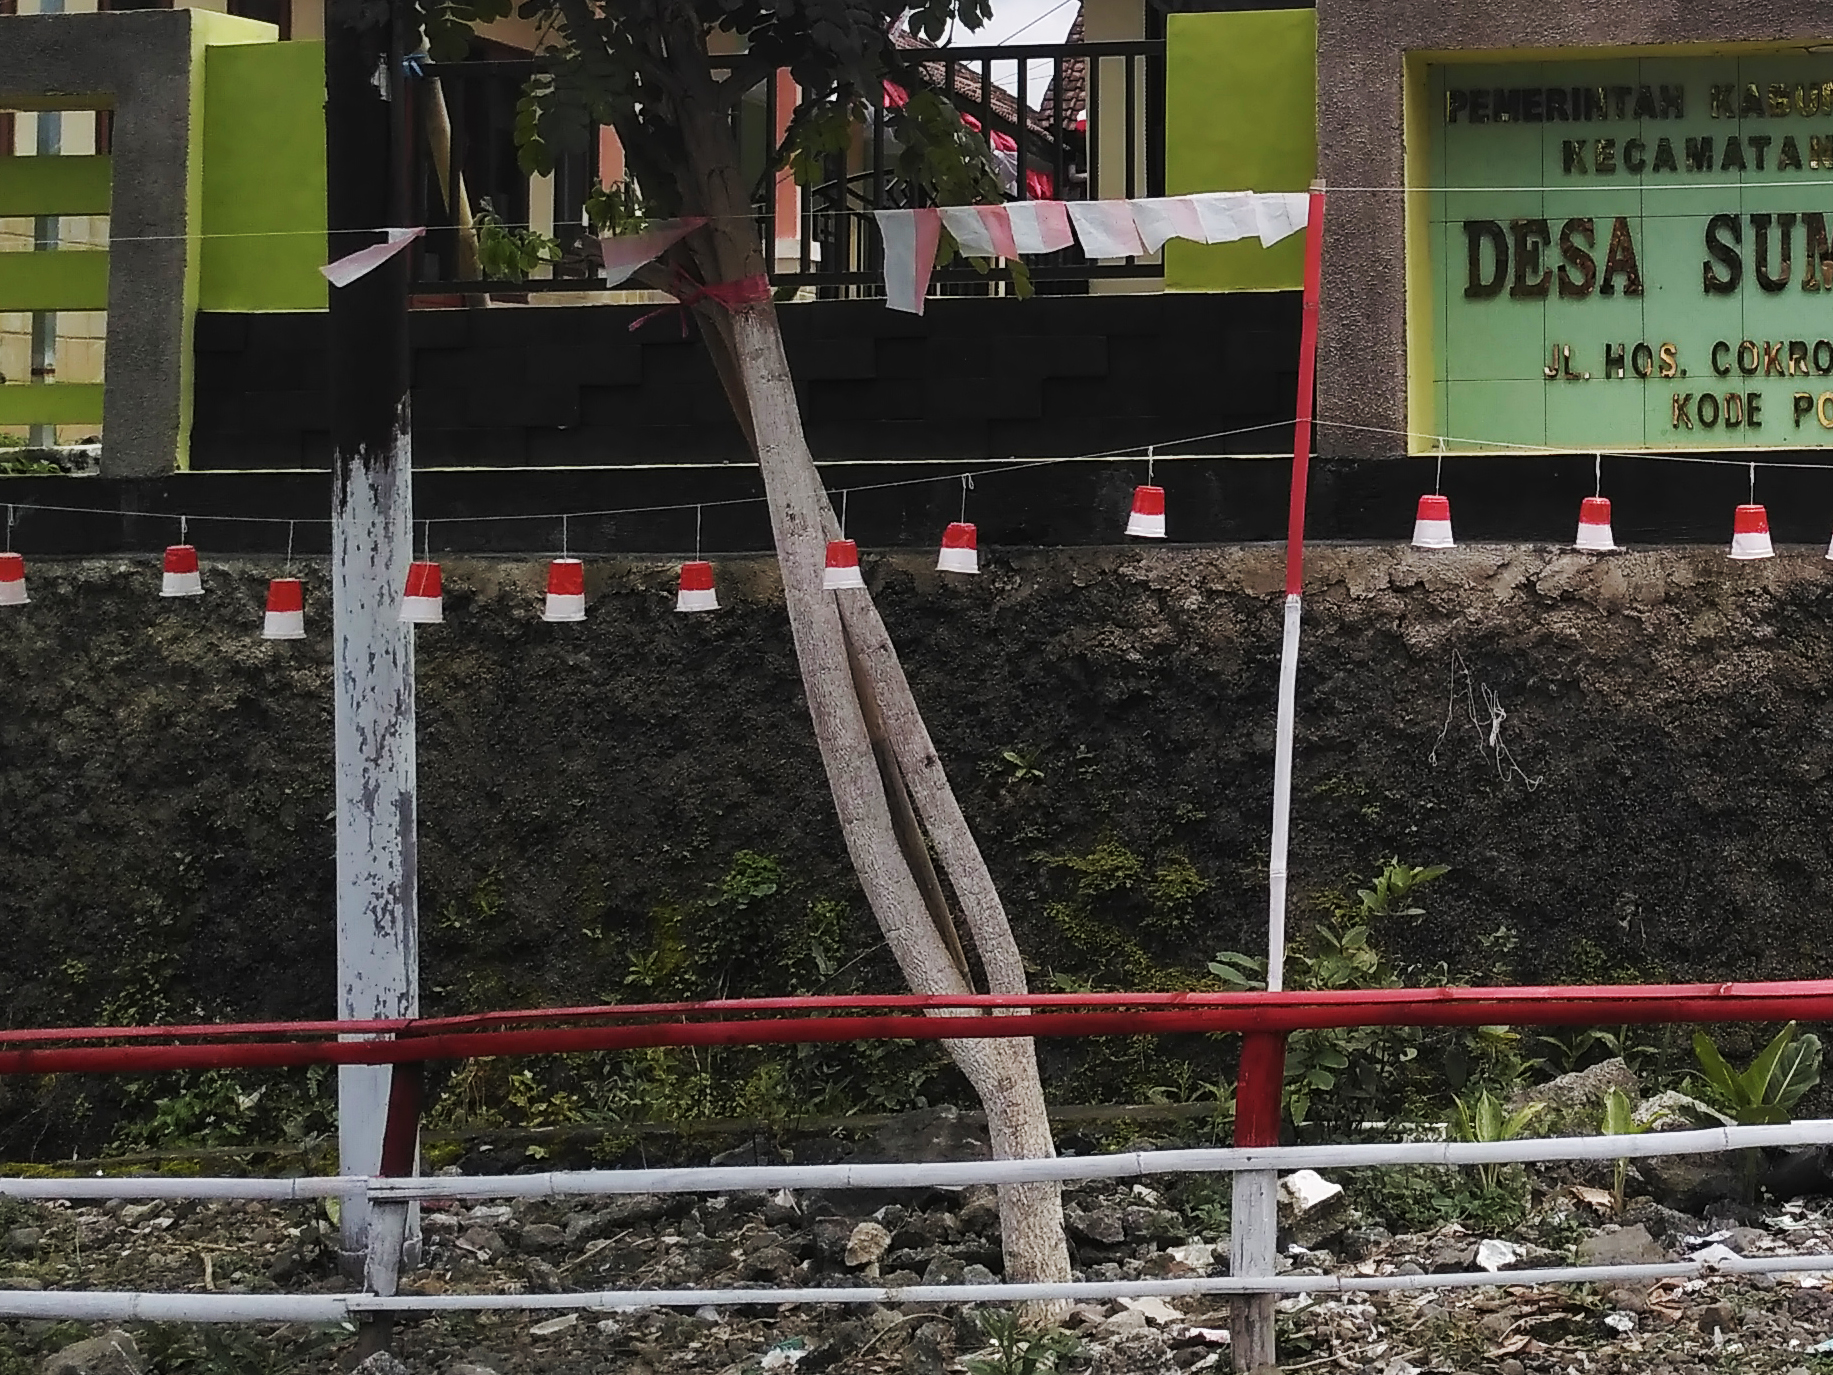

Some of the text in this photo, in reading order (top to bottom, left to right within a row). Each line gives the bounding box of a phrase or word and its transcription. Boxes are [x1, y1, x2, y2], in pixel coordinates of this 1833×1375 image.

[1446, 84, 1685, 124] PEMERINTAH
[1463, 215, 1645, 299] DESA
[1543, 342, 1591, 381] JL.
[1605, 341, 1688, 380] HOS.
[1672, 392, 1763, 430] KODE
